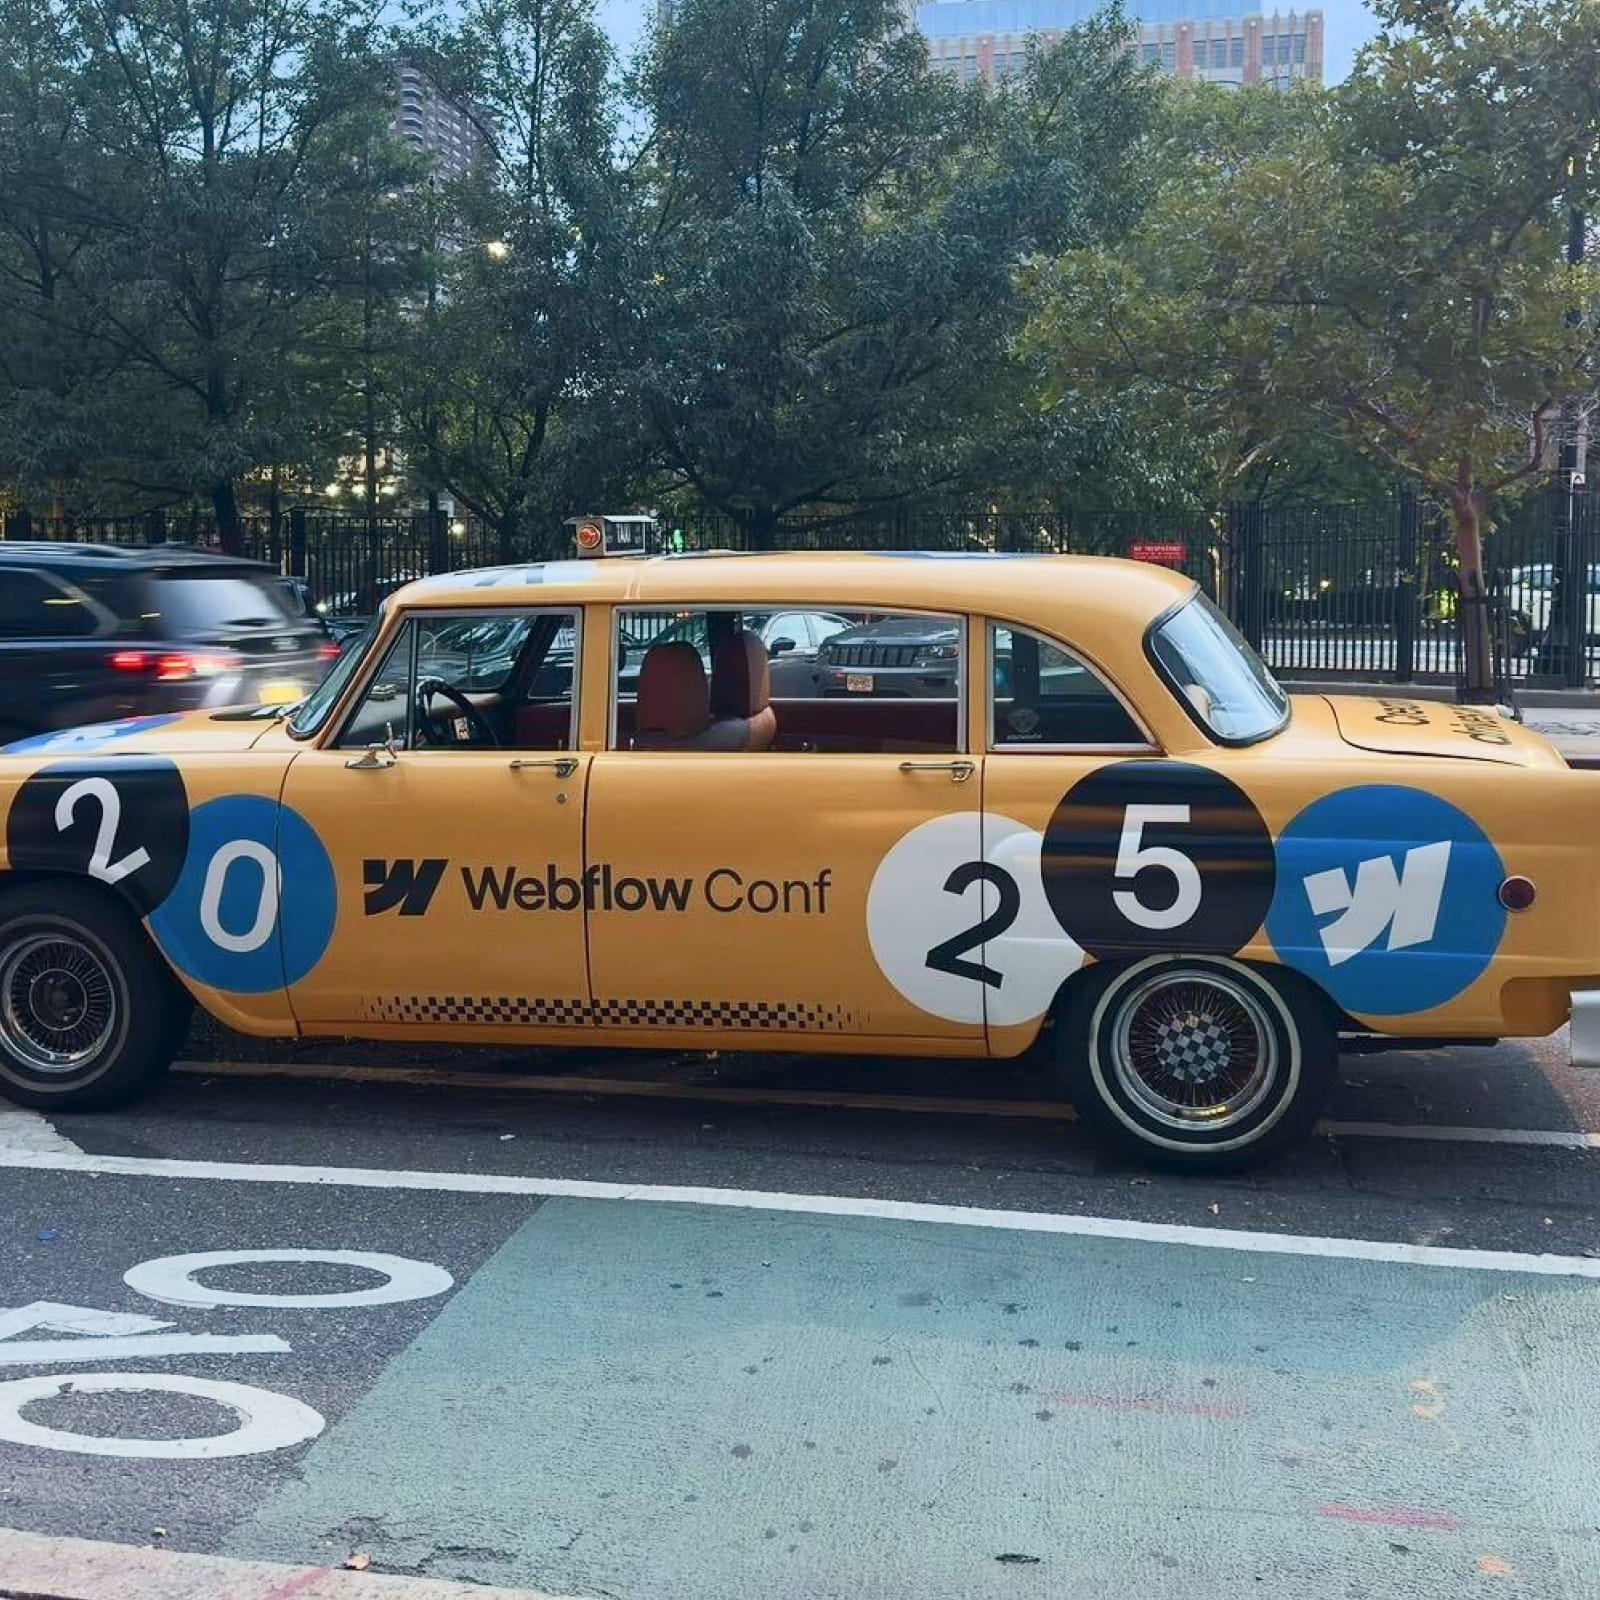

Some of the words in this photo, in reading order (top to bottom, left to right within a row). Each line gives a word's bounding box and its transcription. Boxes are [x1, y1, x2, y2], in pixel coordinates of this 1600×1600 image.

[55, 777, 151, 885] 2
[200, 839, 282, 952] 0
[461, 864, 693, 911] Webflow
[704, 869, 832, 914] Conf
[925, 861, 1020, 989] 2
[1112, 804, 1202, 930] 5
